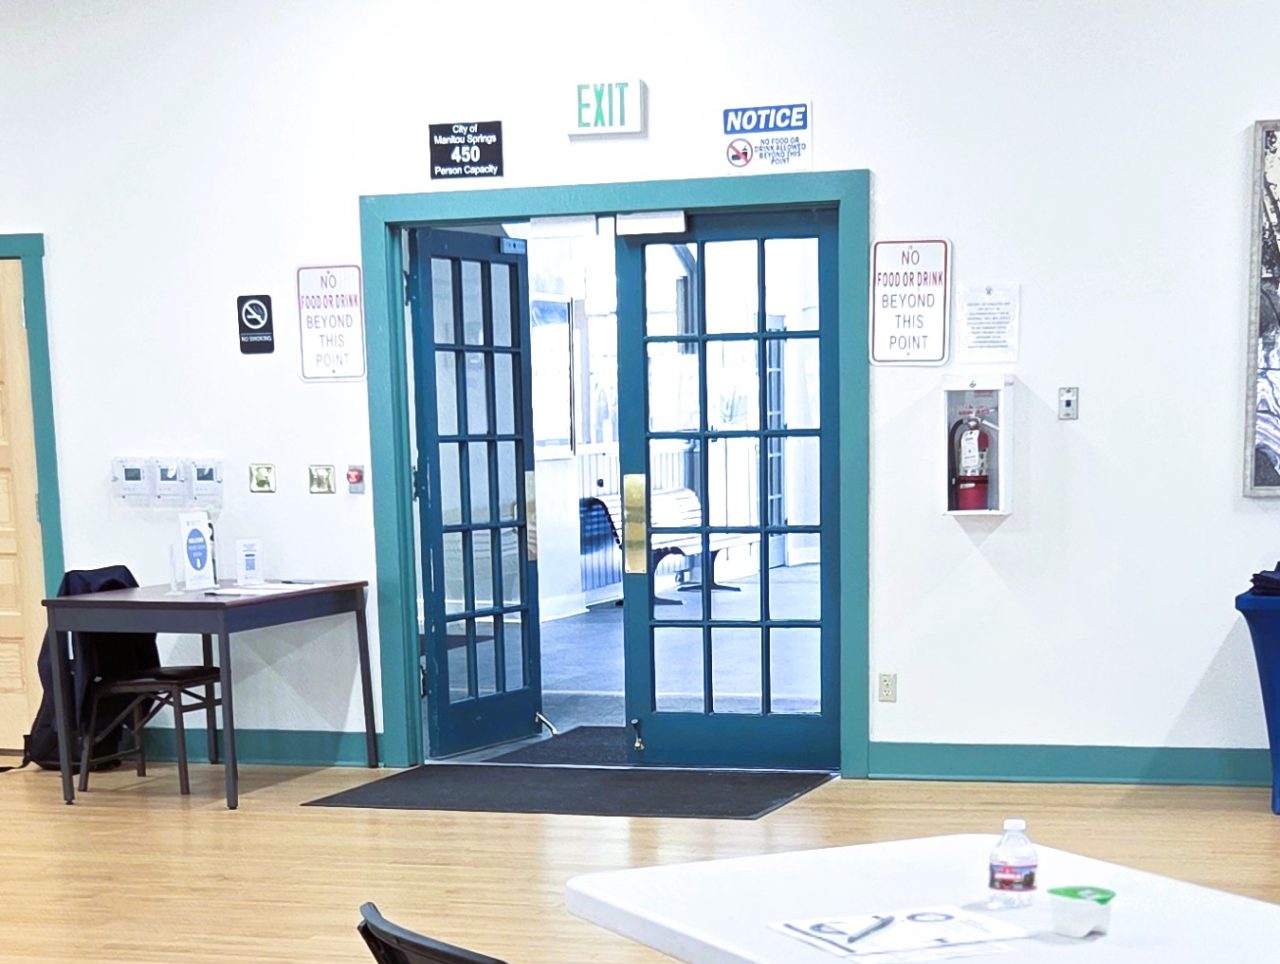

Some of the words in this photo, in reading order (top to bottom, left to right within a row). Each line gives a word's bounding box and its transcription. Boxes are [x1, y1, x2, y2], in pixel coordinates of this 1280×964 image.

[577, 82, 629, 128] EXIT
[726, 107, 806, 132] NOTICE
[452, 124, 468, 135] City
[469, 123, 478, 133] of
[433, 134, 466, 145] Manitou
[466, 133, 497, 145] Springs
[451, 145, 481, 163] 450
[434, 166, 463, 176] Person
[463, 163, 498, 176] Capacity
[901, 250, 920, 265] NO
[320, 274, 337, 289] NO
[877, 272, 901, 287] FOOD
[902, 272, 915, 287] OR
[917, 271, 944, 287] DRINK
[301, 294, 322, 309] FOOD
[323, 294, 335, 309] OR
[336, 293, 359, 308] DRINK
[881, 293, 935, 308] BEYOND
[306, 314, 353, 329] BEYOND
[895, 314, 924, 328] THIS
[319, 333, 345, 348] THIS
[889, 335, 929, 350] POINT
[315, 352, 350, 367] POINT
